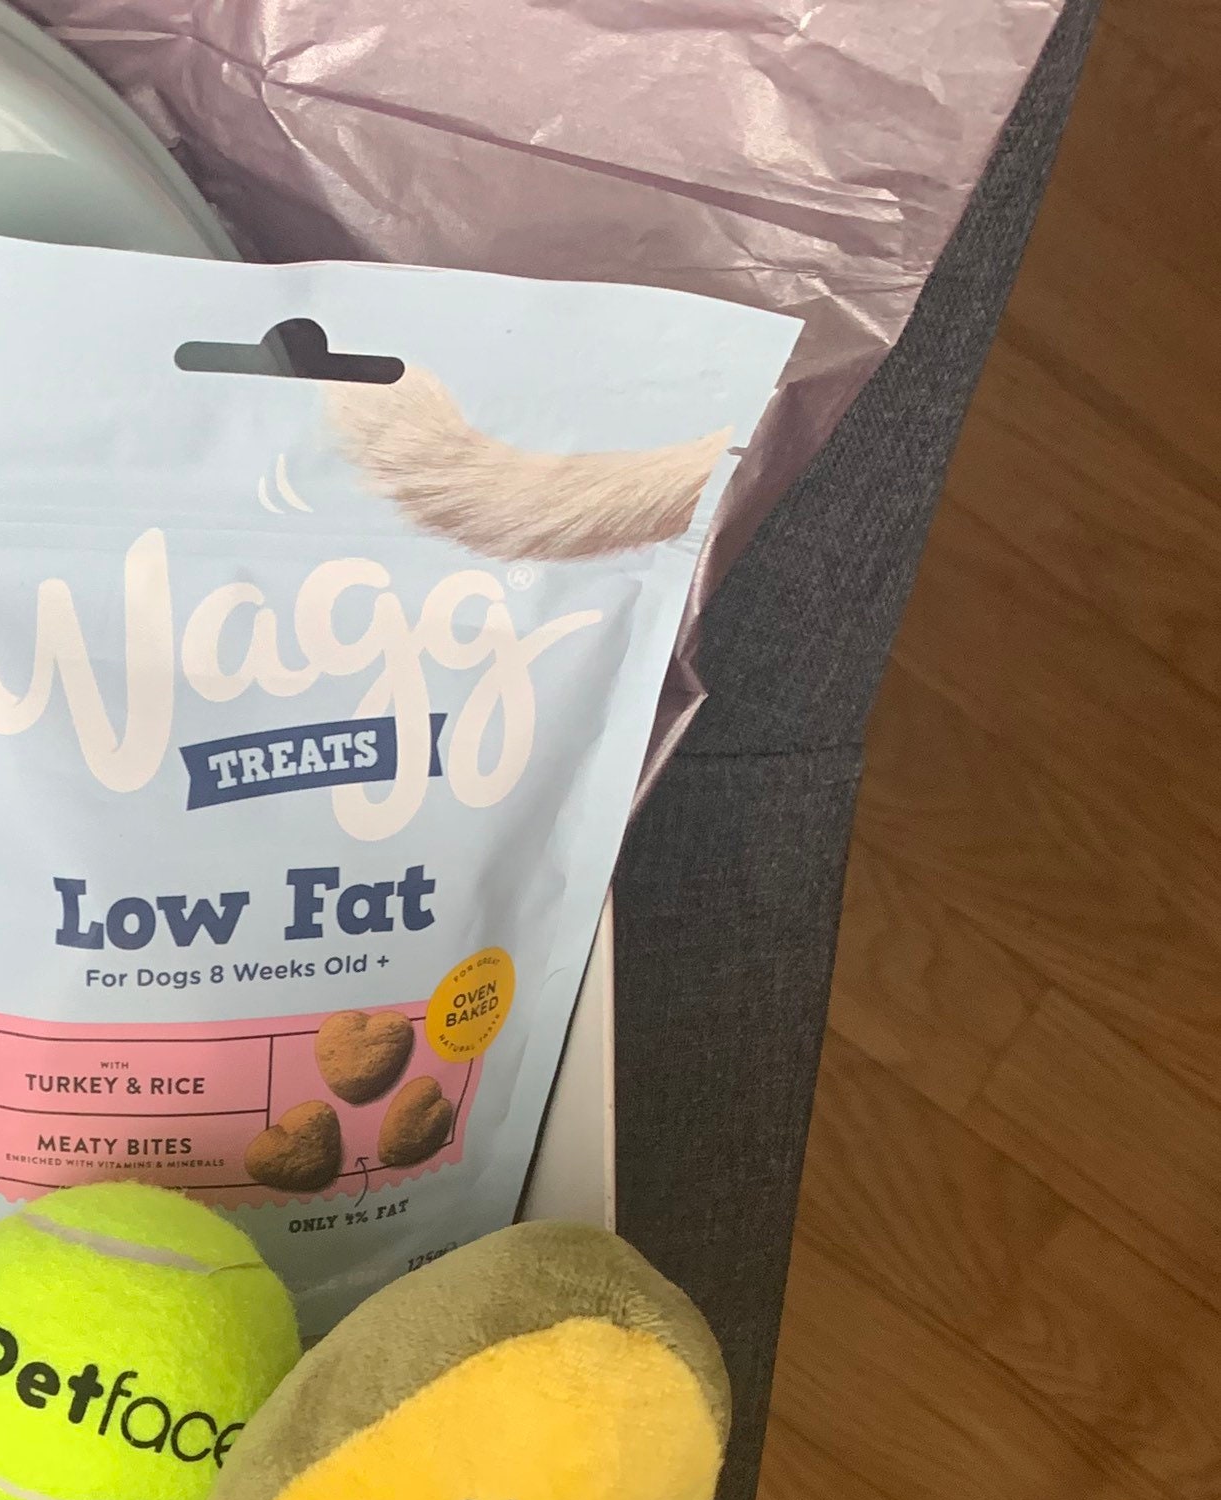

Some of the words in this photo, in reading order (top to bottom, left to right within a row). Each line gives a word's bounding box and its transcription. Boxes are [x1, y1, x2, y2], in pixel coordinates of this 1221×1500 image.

[208, 731, 379, 789] TREATS
[53, 877, 250, 950] Low
[284, 865, 436, 940] Fat
[86, 969, 127, 987] For
[137, 968, 201, 989] Dogs
[210, 965, 224, 983] 8
[233, 959, 316, 982] Weeks
[324, 954, 367, 975] Old
[453, 980, 497, 1008] OVEN
[445, 996, 499, 1027] BAKED
[100, 1061, 129, 1069] WITH
[25, 1073, 118, 1094] TURKEY
[126, 1077, 141, 1095] &
[151, 1077, 205, 1095] RICE
[37, 1135, 118, 1155] MEATY
[127, 1138, 192, 1155] BITES
[5, 1153, 62, 1166] ENRICHED
[66, 1159, 94, 1168] WITH
[97, 1160, 152, 1169] VITAMINS
[156, 1161, 163, 1169] &
[167, 1158, 225, 1168] MINERALS
[288, 1214, 339, 1234] ONLY
[345, 1210, 369, 1226] 4%
[375, 1199, 410, 1220] FAT
